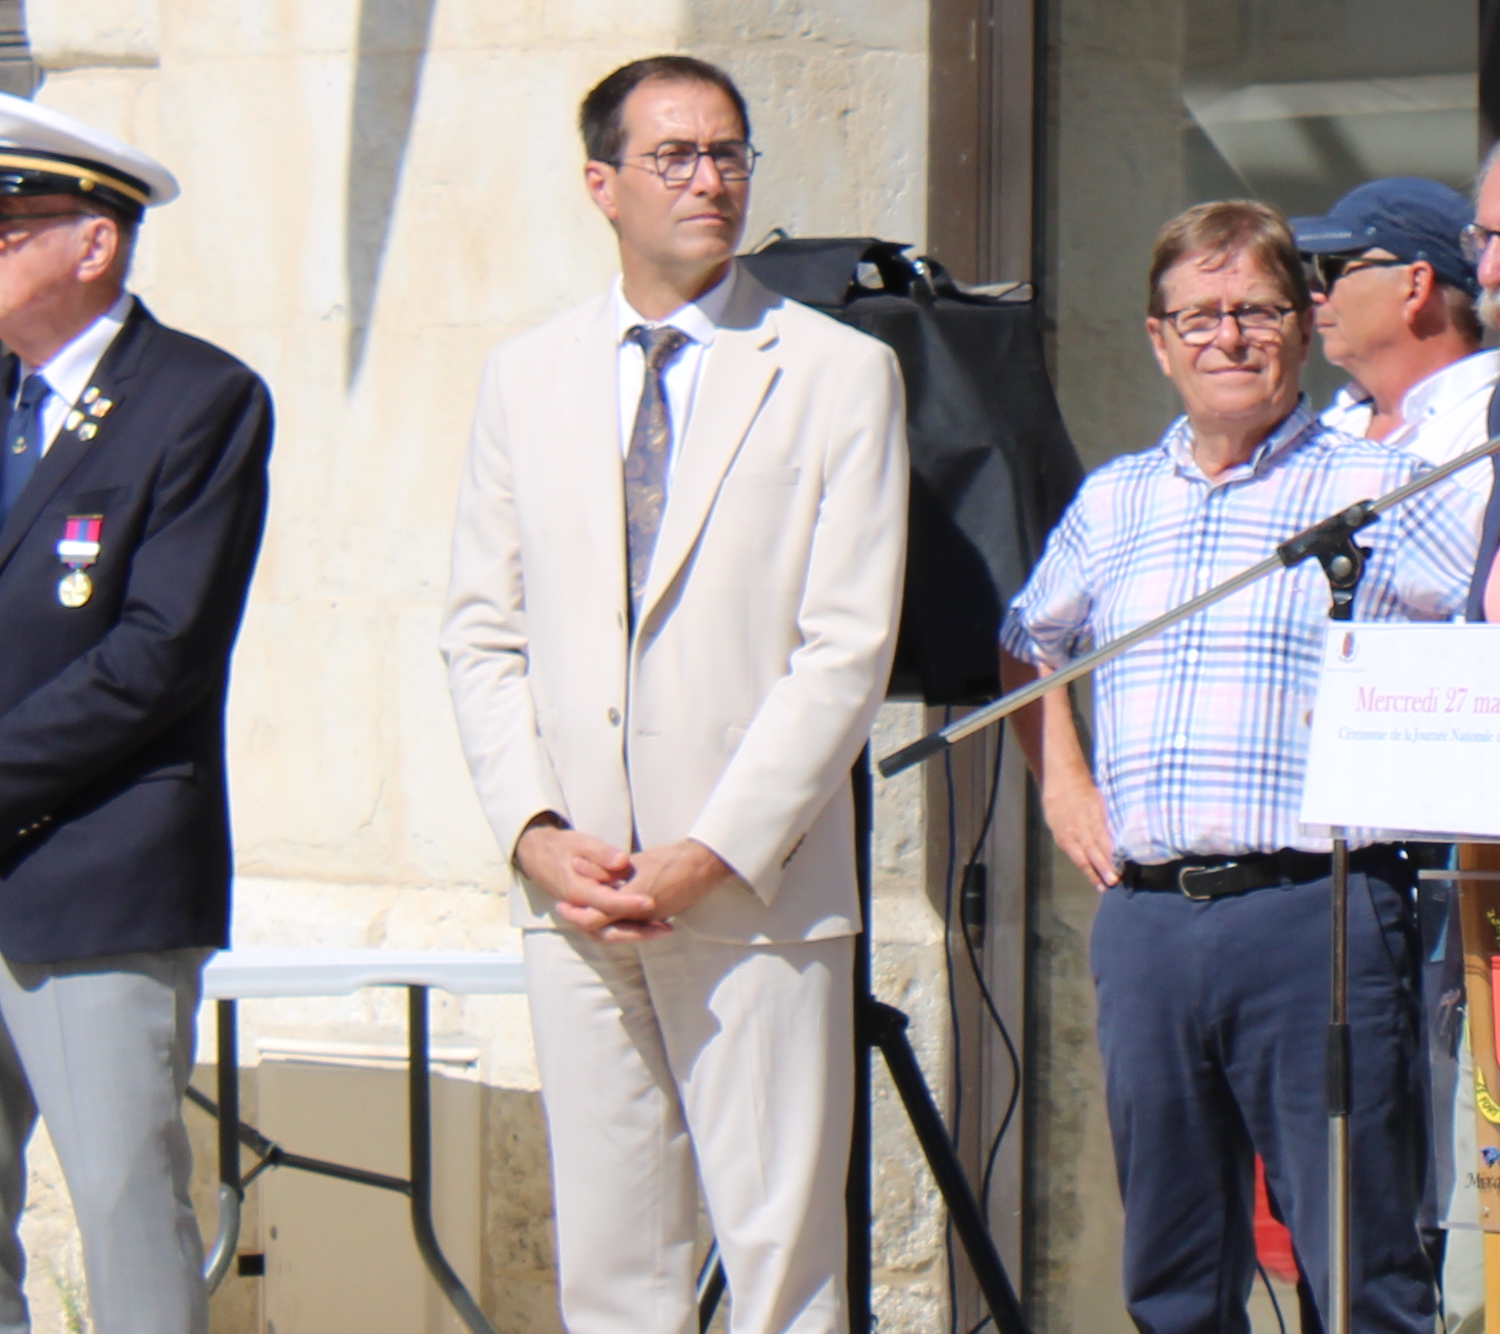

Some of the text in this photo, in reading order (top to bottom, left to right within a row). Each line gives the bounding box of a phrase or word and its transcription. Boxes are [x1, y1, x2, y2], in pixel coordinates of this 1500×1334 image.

[1354, 685, 1440, 714] Mercredi
[1443, 687, 1469, 714] 27
[1389, 727, 1402, 741] de
[1404, 727, 1412, 741] la
[1412, 727, 1449, 743] Journée
[1450, 728, 1494, 742] Nationale
